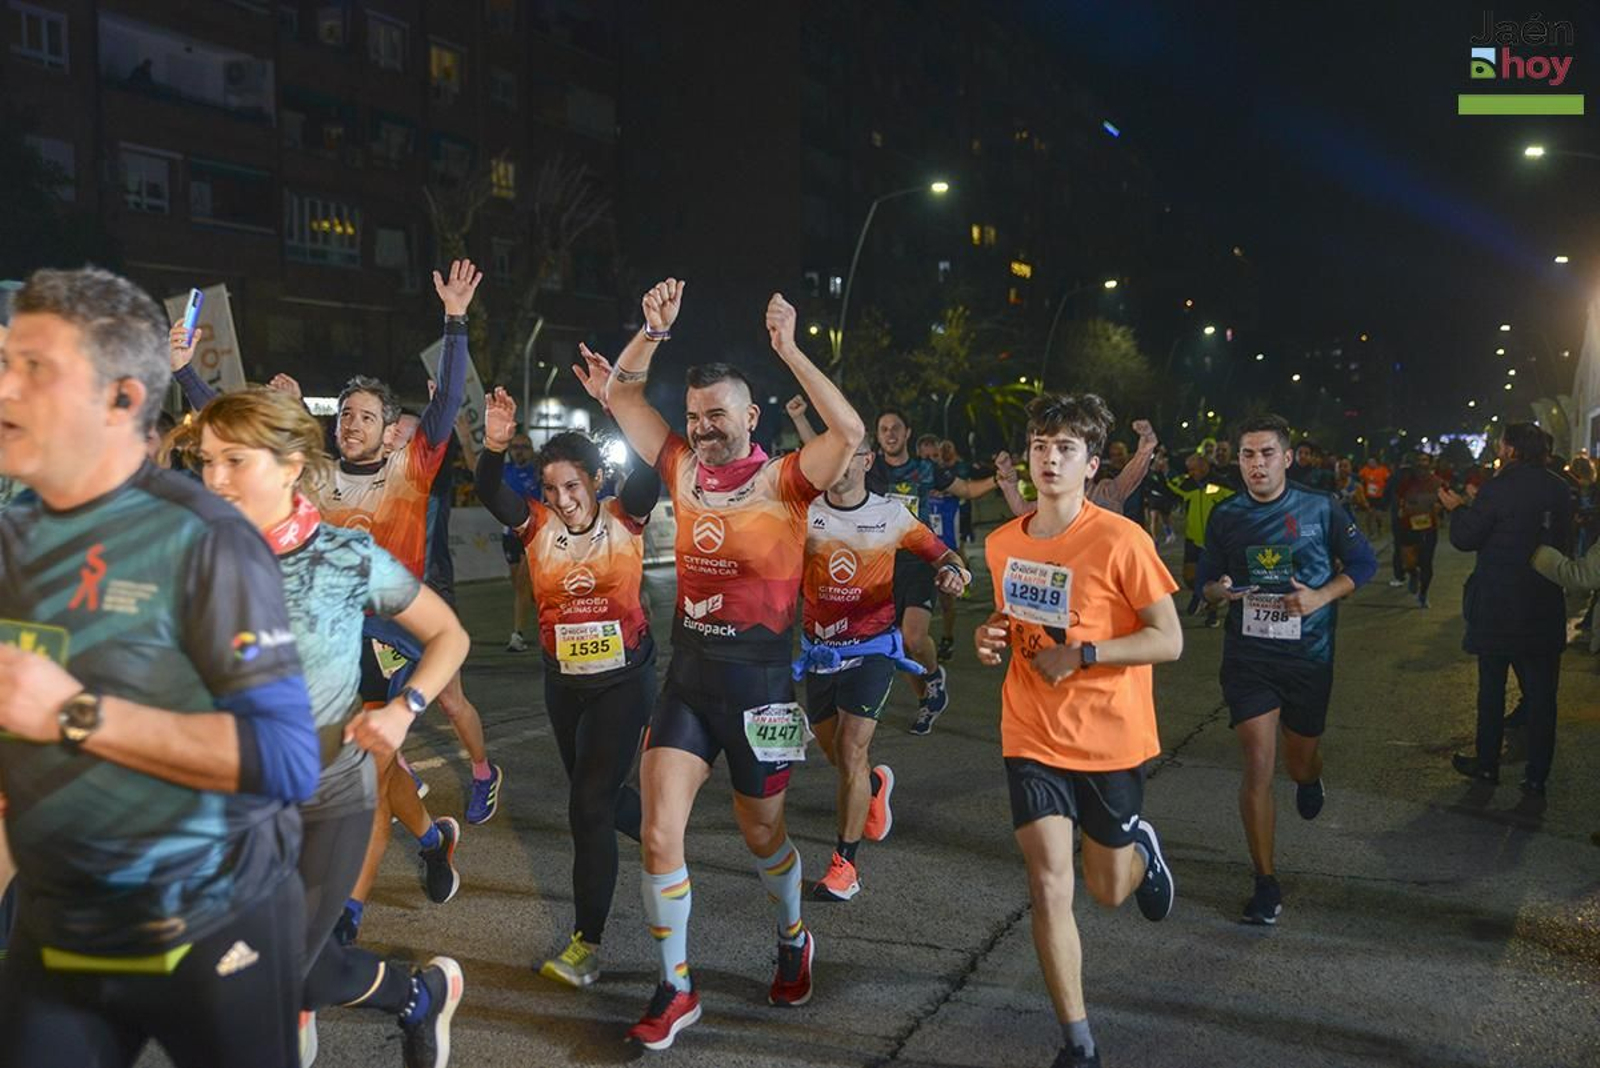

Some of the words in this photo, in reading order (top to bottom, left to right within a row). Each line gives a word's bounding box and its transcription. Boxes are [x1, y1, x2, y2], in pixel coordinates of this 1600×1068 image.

[1010, 582, 1061, 606] 12919
[683, 616, 736, 637] Europack
[569, 639, 610, 657] 1535
[757, 724, 798, 741] 4147
